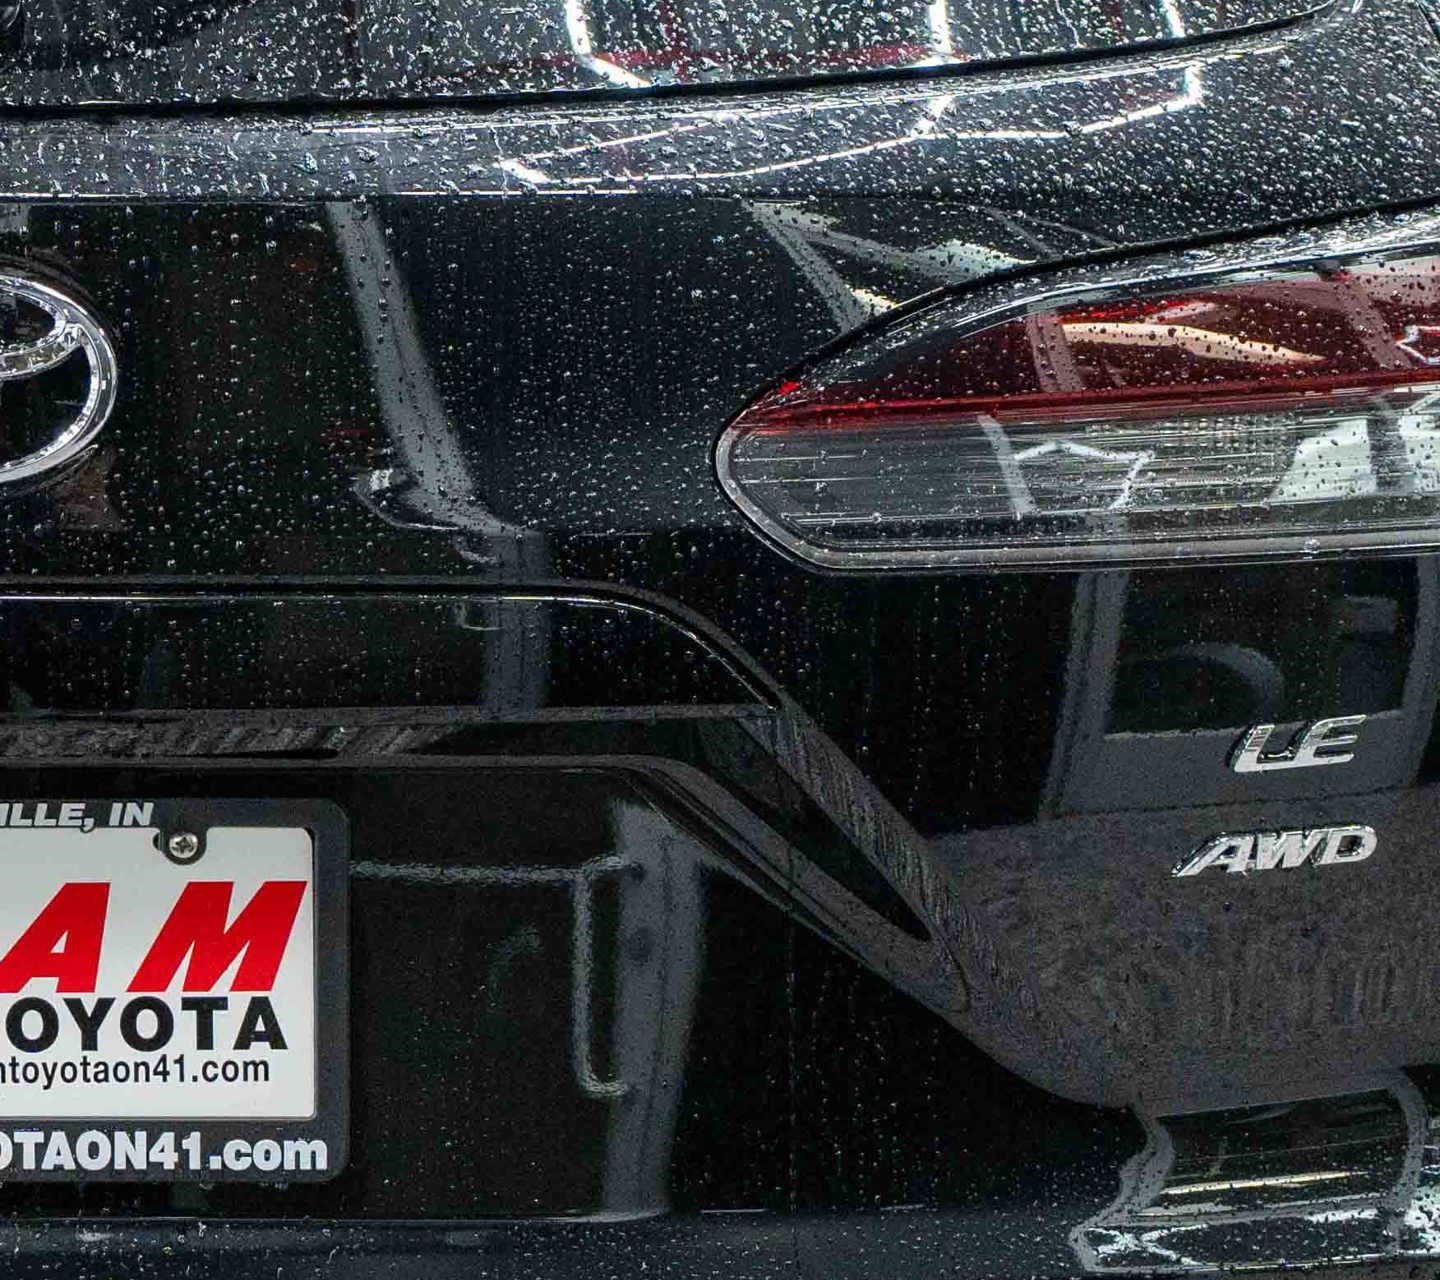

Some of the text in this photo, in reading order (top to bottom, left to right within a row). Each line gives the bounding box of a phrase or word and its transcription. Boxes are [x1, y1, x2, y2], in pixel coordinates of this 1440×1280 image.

[1232, 714, 1366, 773] LE
[108, 802, 154, 827] IN
[1171, 825, 1378, 877] AWD
